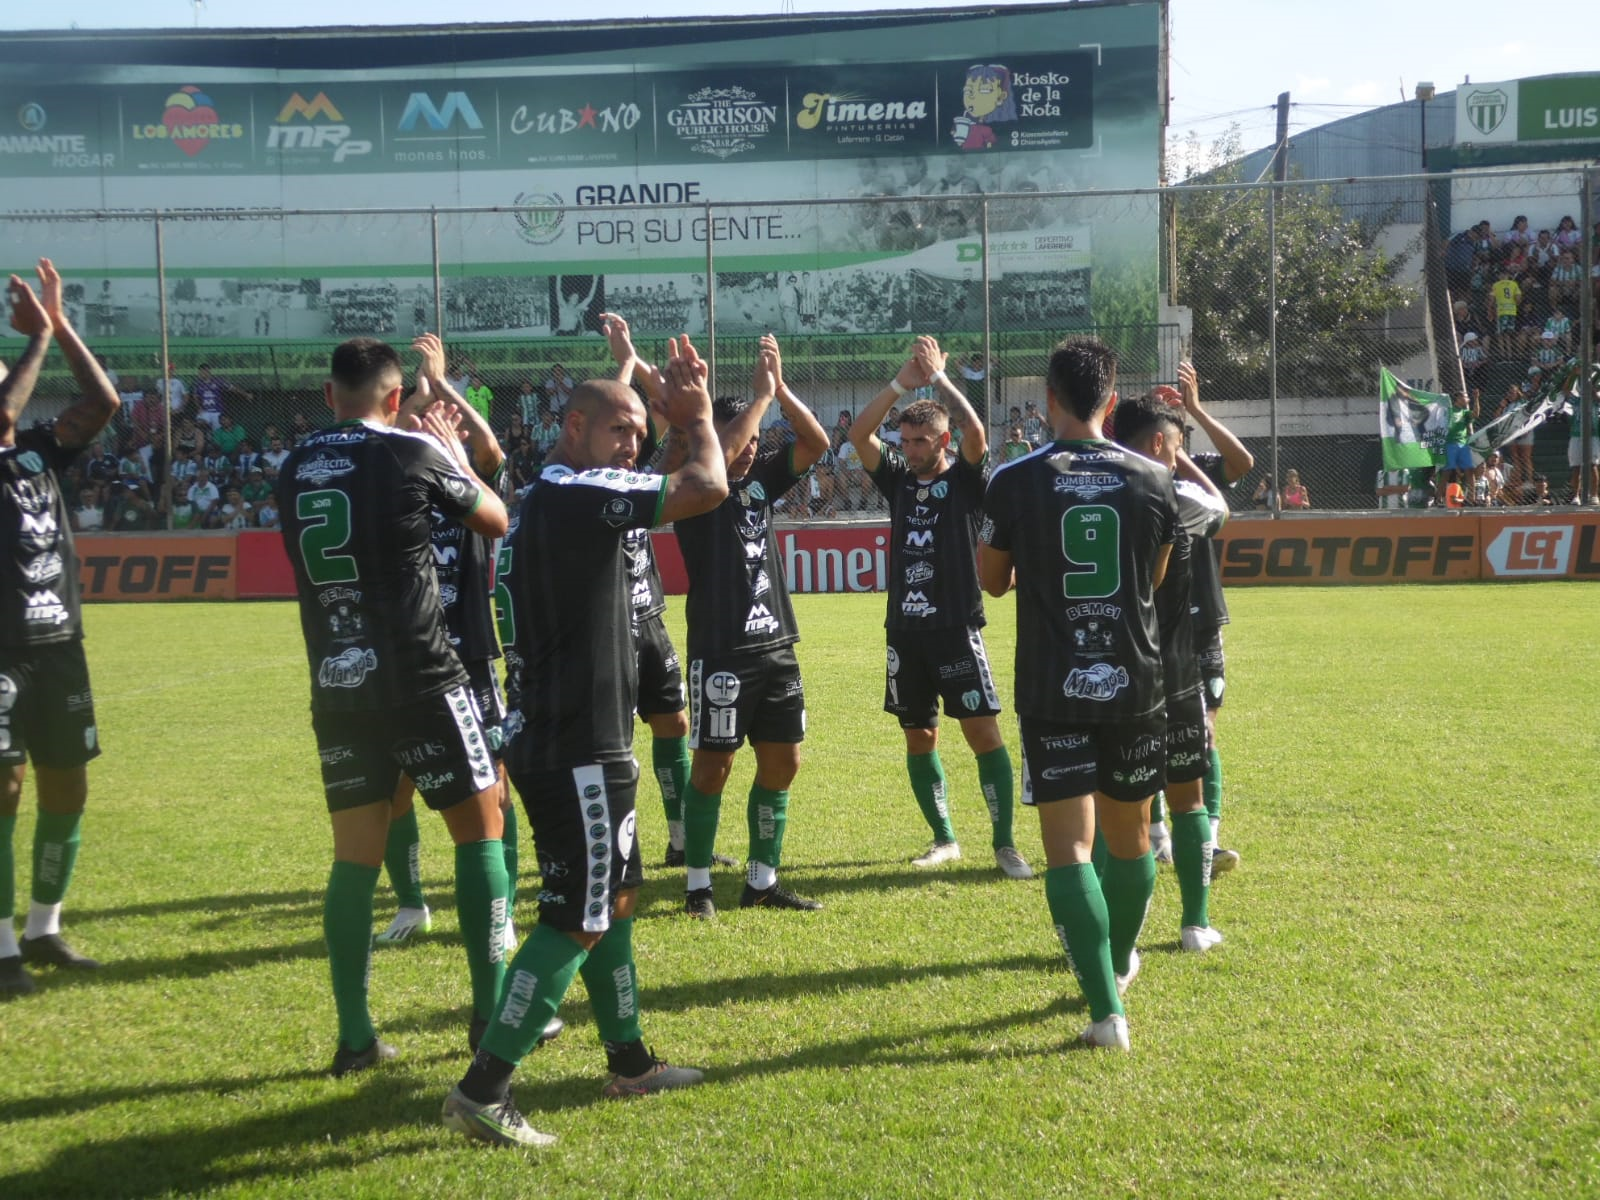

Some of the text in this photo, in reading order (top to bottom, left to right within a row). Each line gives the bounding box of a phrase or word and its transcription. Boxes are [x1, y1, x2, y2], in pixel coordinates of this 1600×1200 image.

[1021, 85, 1061, 102] de la
[712, 100, 732, 108] THE
[1020, 101, 1061, 117] Nota
[666, 105, 778, 127] GARRISON
[1544, 107, 1598, 129] LUIS
[132, 123, 244, 139] LOS AMORES
[675, 125, 723, 136] PUBLIC
[725, 123, 770, 134] HOUSE
[715, 139, 731, 148] BAR
[52, 153, 116, 169] HOGAR
[394, 150, 443, 163] mones
[575, 181, 701, 206] GRANDE
[576, 217, 635, 246] POR
[645, 217, 683, 244] SU
[316, 431, 367, 445] ATTAIN
[1055, 475, 1120, 486] CUMBRECITA
[296, 488, 361, 586] 2
[1061, 504, 1121, 599] 9
[1217, 536, 1474, 578] SQTOFF
[80, 555, 231, 593] TOFF
[1065, 602, 1122, 621] BEMGI
[709, 707, 736, 738] 10
[1045, 735, 1090, 751] TRUCK
[1173, 752, 1188, 761] TU
[416, 772, 434, 784] TU
[416, 772, 455, 792] BAZAR
